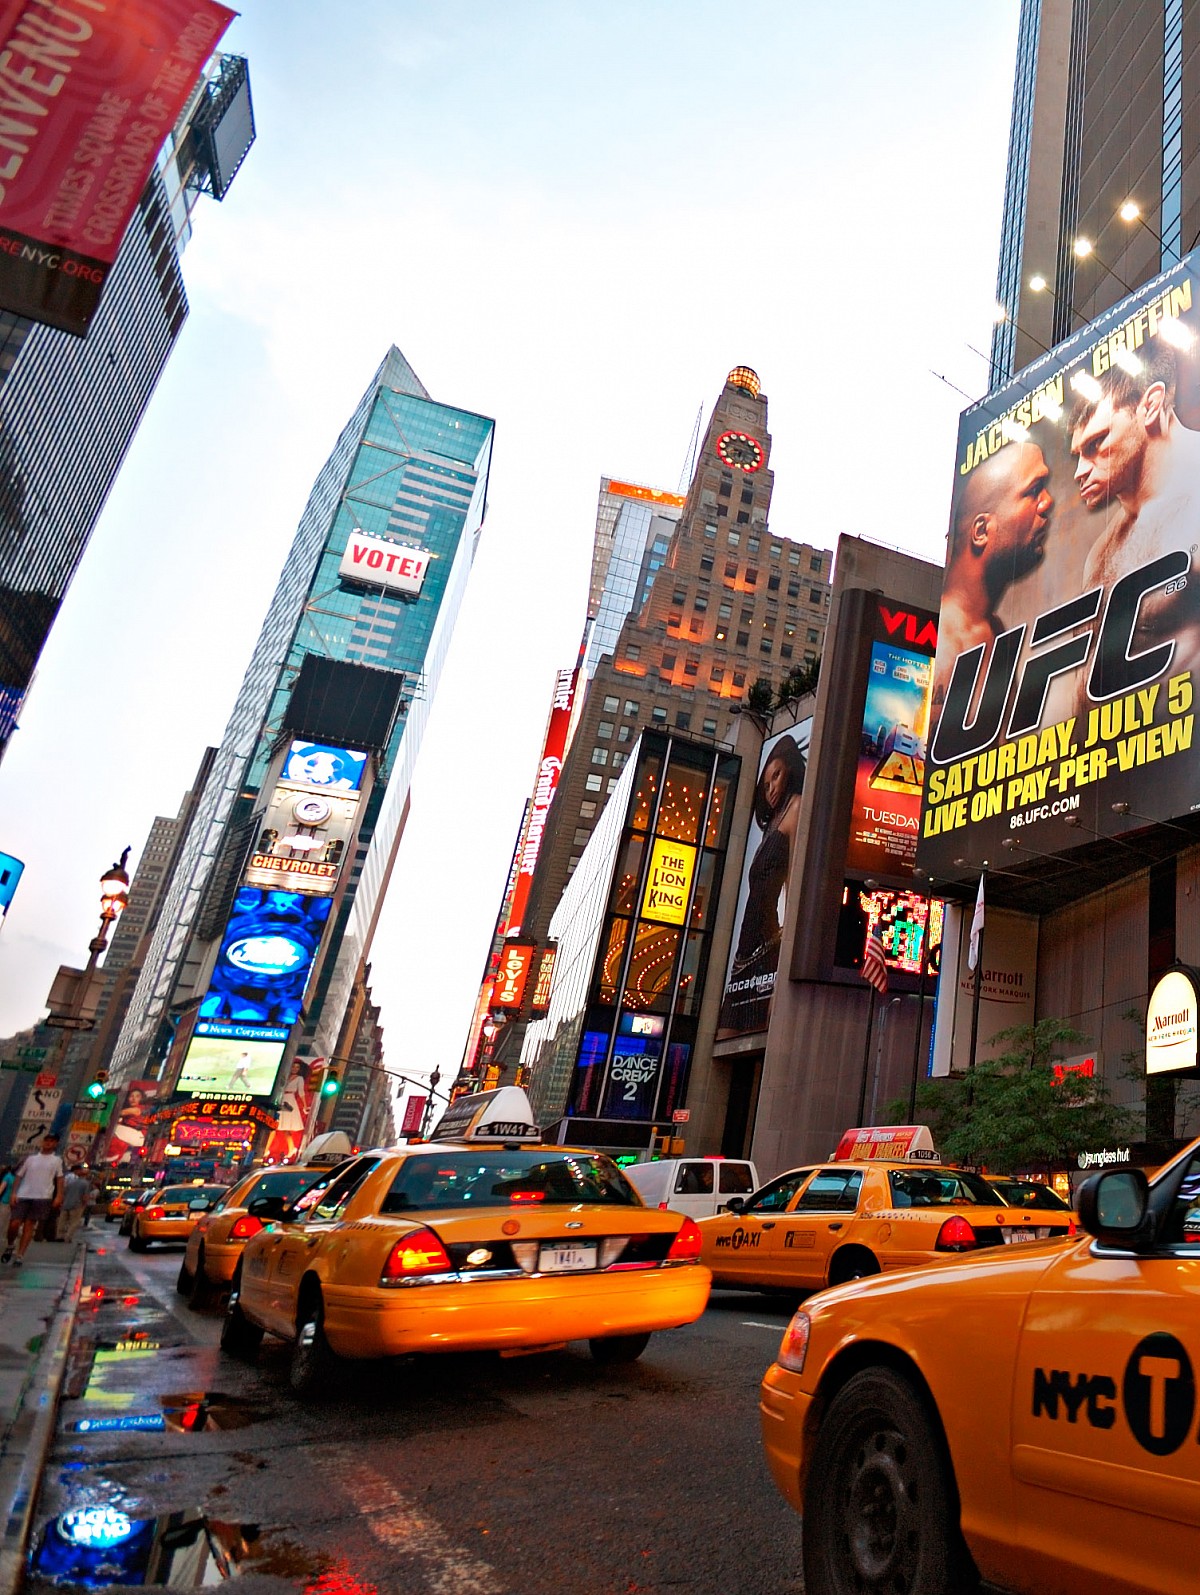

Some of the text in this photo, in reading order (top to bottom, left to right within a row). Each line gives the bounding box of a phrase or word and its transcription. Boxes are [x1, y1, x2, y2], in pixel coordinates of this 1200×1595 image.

[0, 0, 106, 206] NVENU
[83, 11, 219, 245] CROSSROADS OF THE WORLD
[43, 91, 131, 229] TIMES SQUARE
[1022, 333, 1081, 378] FIGHTING
[1083, 256, 1193, 336] CHAMPIONSHIP
[1098, 285, 1174, 345] CHAMPIONSHIP
[1092, 278, 1193, 377] GRIFFIN
[353, 544, 422, 579] VOTE!
[1165, 577, 1187, 596] 86
[879, 606, 938, 649] VIA
[931, 550, 1192, 765] UFC
[928, 671, 1194, 805] SATURDAY, JULY 5
[923, 714, 1195, 839] LIVE ON PAY-PER-VIEW
[863, 807, 919, 830] TUESDAY
[1009, 793, 1081, 830] 86.UFC.COM
[251, 855, 337, 877] CHEVROLET
[662, 855, 685, 870] THE
[652, 868, 686, 887] LION
[648, 889, 683, 908] KING
[1000, 988, 1031, 999] MARQUIS
[1152, 1007, 1189, 1033] Marriott
[612, 1055, 658, 1071] DANCE
[611, 1068, 655, 1083] CREW
[44, 1090, 60, 1099] NO
[191, 1091, 253, 1102] Panasonic
[623, 1081, 638, 1101] 2
[202, 1102, 217, 1114] OF
[220, 1104, 247, 1116] CALF
[21, 1122, 36, 1131] NO
[493, 1123, 525, 1135] 1W41
[1117, 1147, 1130, 1162] hut
[1031, 1367, 1117, 1430] NYC
